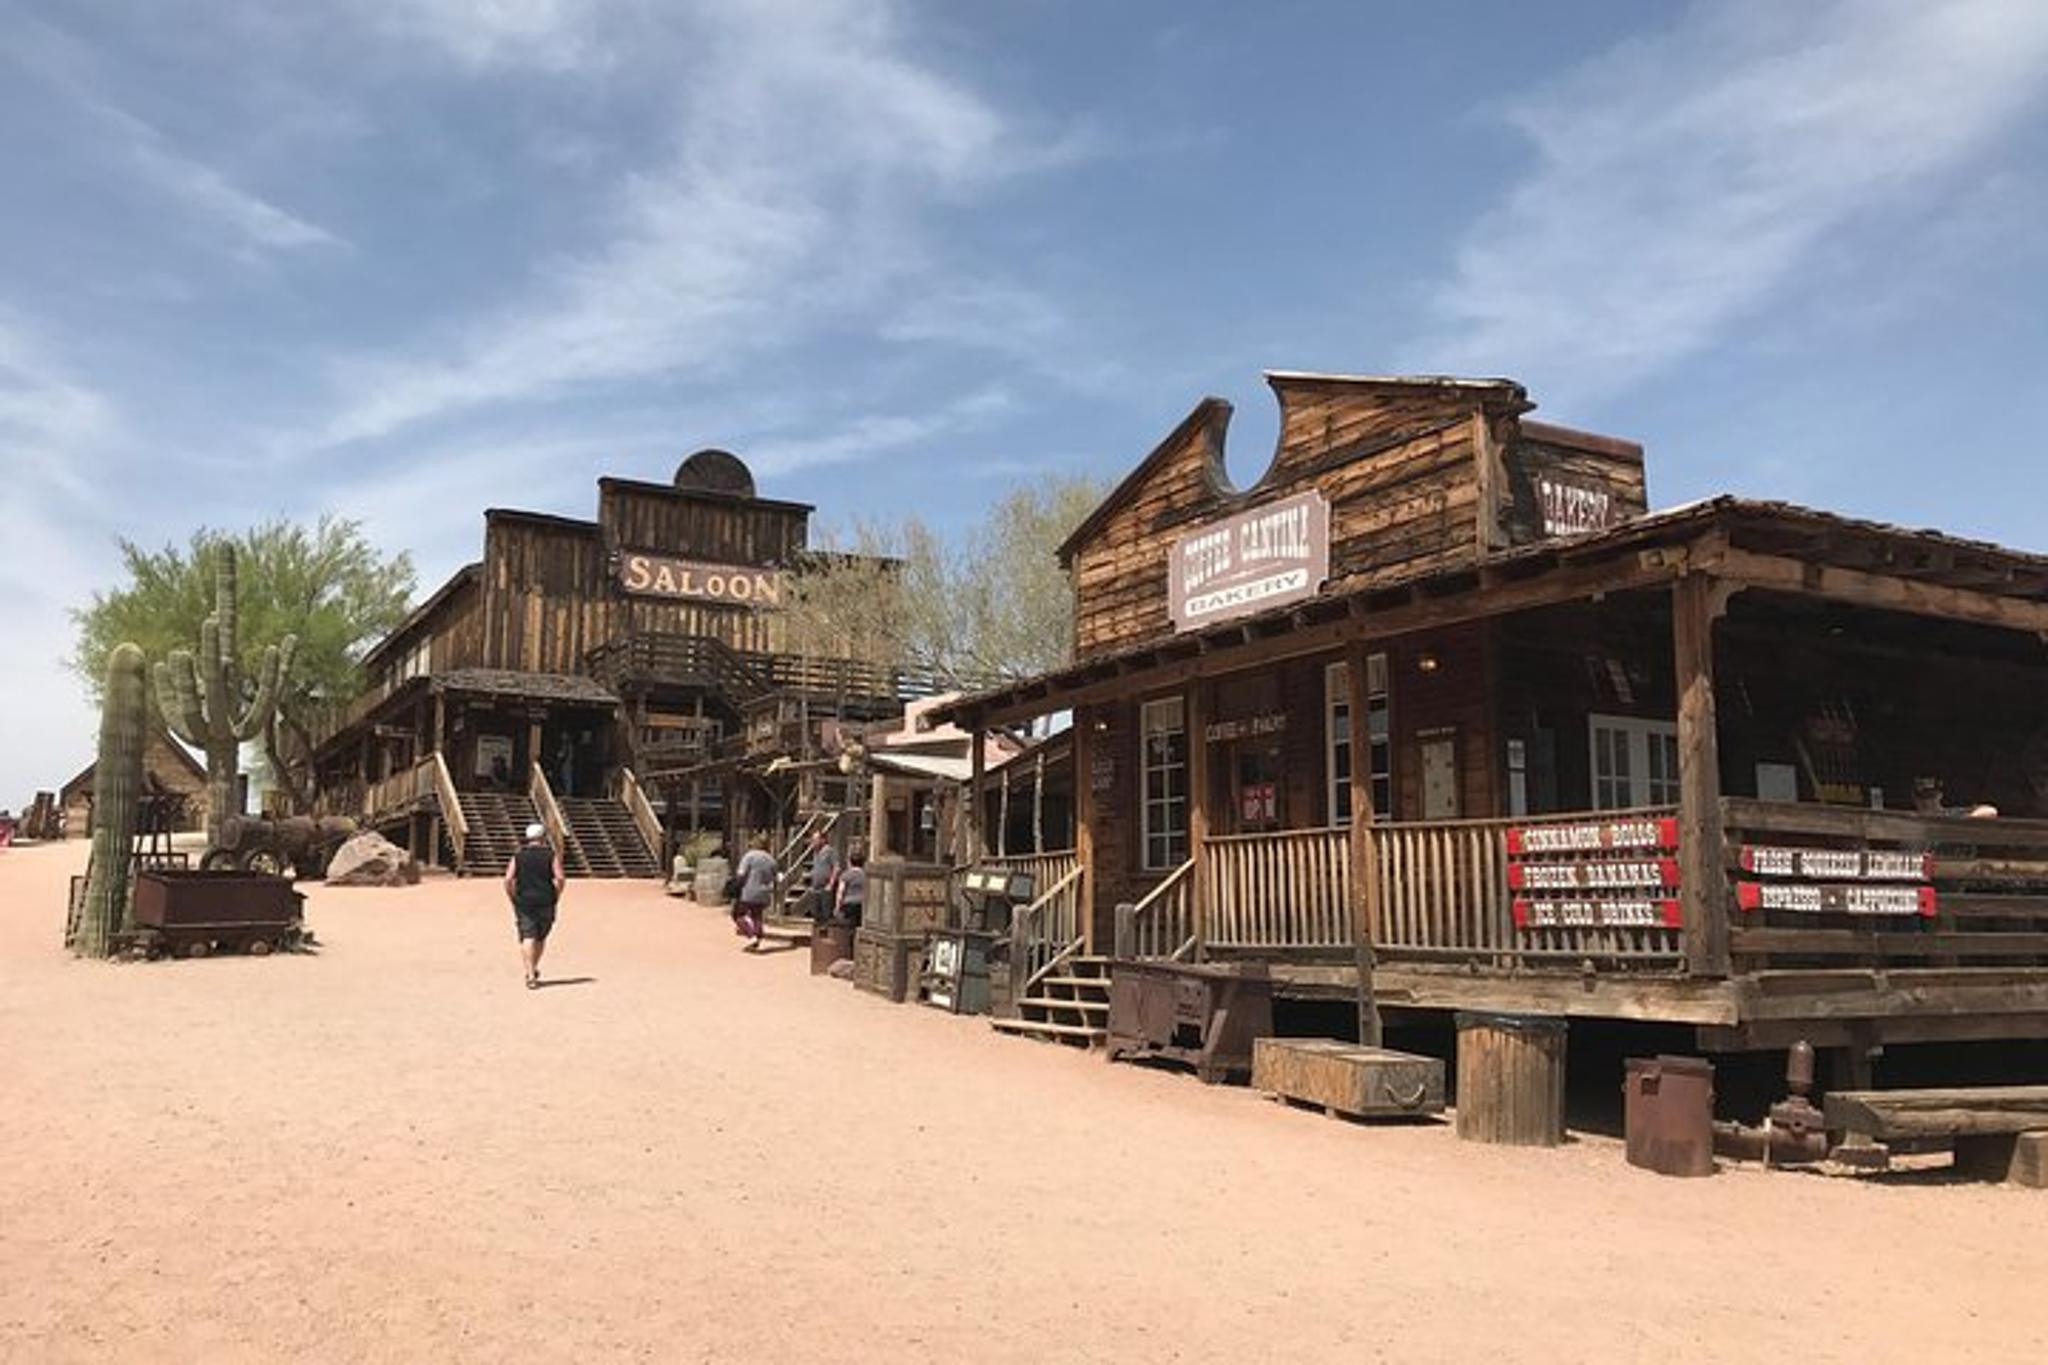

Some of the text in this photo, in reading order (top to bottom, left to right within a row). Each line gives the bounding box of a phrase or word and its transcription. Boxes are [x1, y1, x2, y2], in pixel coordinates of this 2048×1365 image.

[624, 556, 780, 603] SALOON
[1190, 573, 1299, 612] BAKERY
[1611, 823, 1657, 846] ROLLS
[1523, 864, 1662, 888] FROZEN BANANAS
